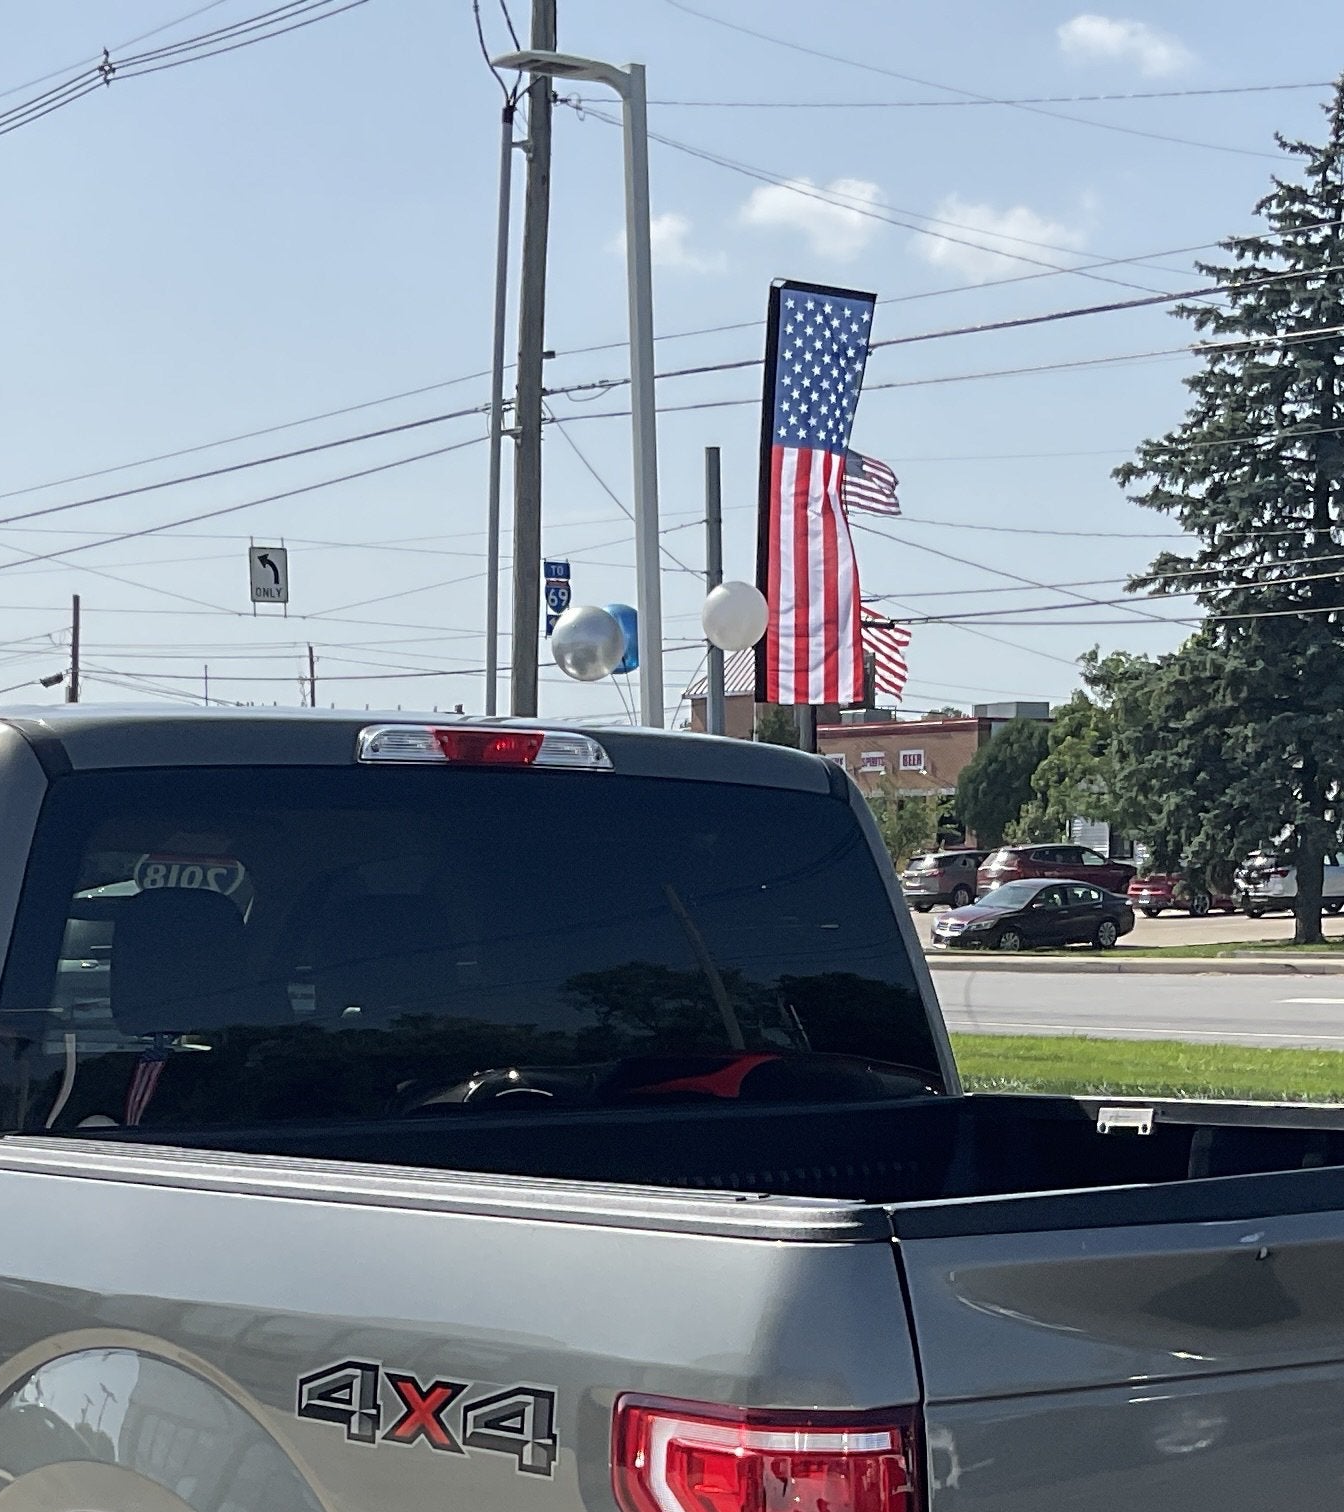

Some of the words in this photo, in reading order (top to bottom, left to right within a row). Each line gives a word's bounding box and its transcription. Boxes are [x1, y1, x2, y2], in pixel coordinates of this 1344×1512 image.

[550, 565, 564, 576] TO
[255, 587, 282, 598] ONLY
[548, 588, 569, 607] 69
[902, 754, 922, 767] BEER
